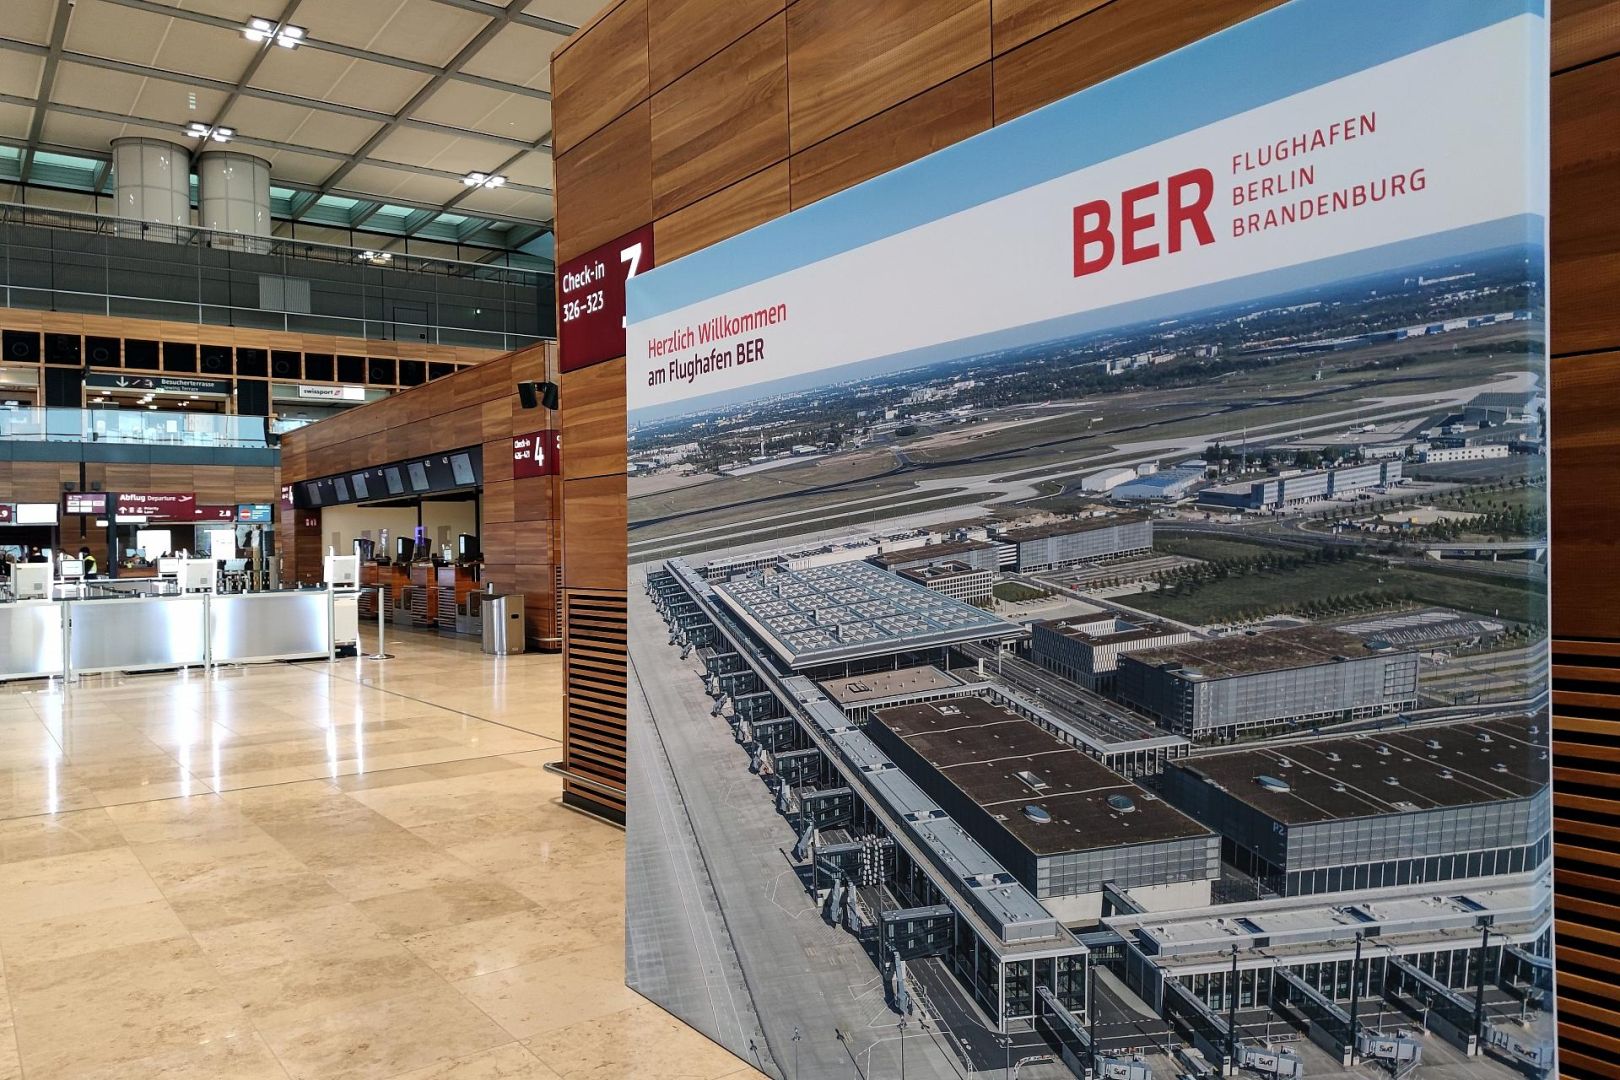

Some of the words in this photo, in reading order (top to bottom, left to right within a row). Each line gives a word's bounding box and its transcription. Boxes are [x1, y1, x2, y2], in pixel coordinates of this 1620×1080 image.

[1232, 111, 1377, 174] FLUGHAFEN
[1232, 165, 1315, 206] BERLIN
[1232, 168, 1426, 238] BRANDENBURG
[1073, 167, 1216, 278] BER
[562, 260, 605, 293] Check-in
[648, 326, 695, 359] Herzlich
[698, 303, 787, 345] Willkommen
[648, 367, 666, 387] am
[669, 347, 732, 383] Flughafen
[736, 337, 764, 366] BER
[303, 388, 333, 396] swissport
[534, 436, 545, 467] 4
[120, 494, 146, 502] Abflug
